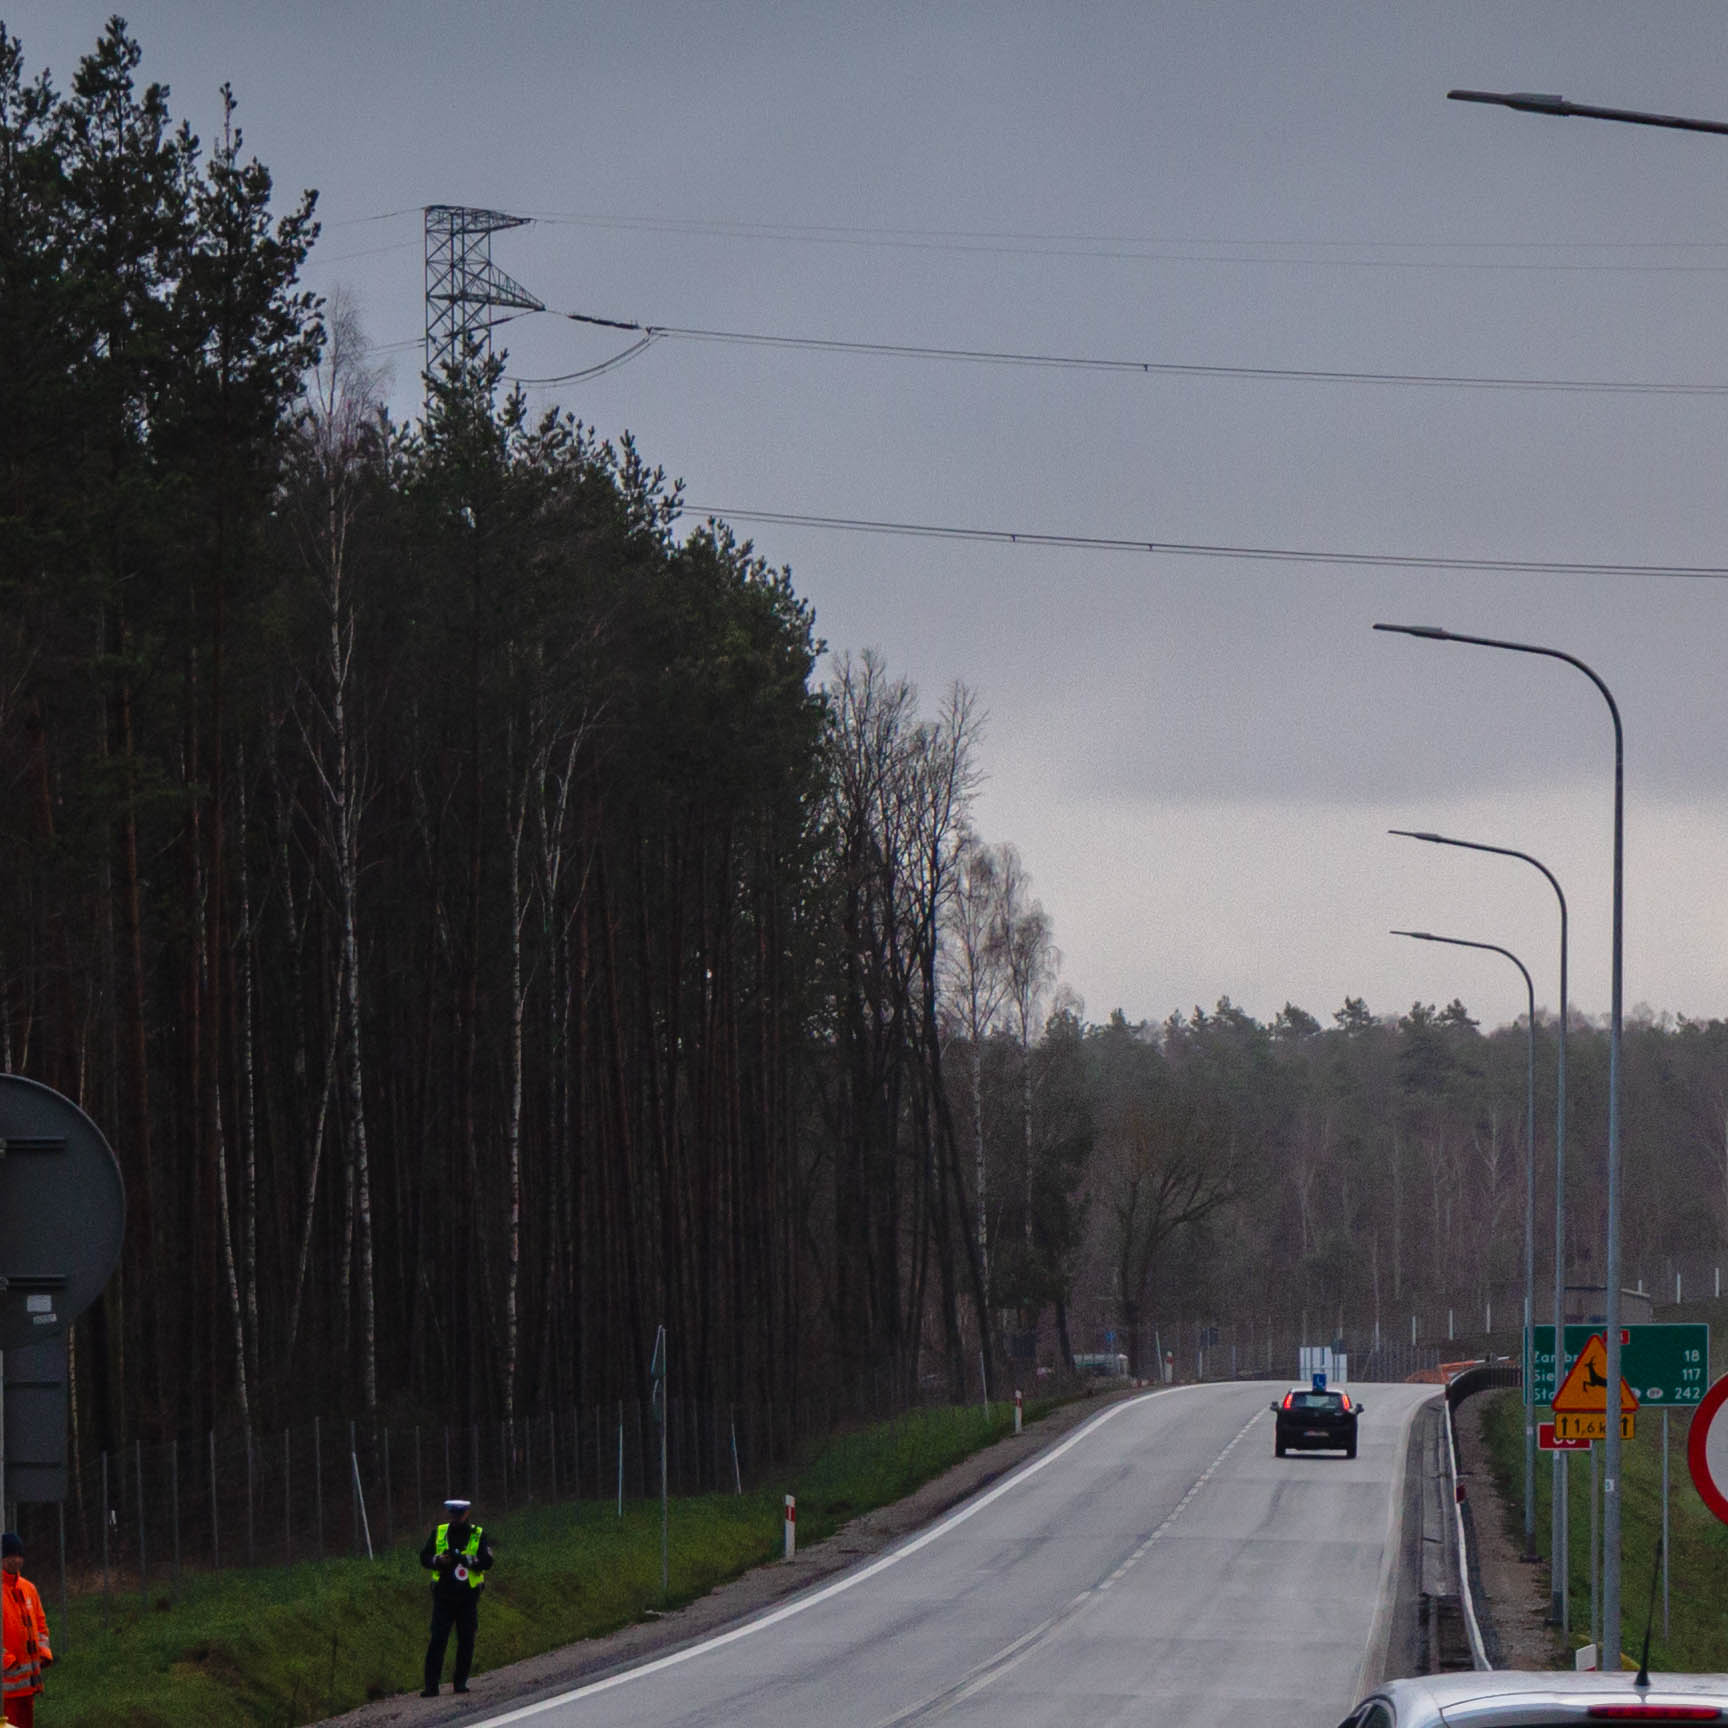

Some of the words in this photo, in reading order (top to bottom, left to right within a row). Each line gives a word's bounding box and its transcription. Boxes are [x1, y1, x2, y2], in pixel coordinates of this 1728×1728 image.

[1683, 1349, 1701, 1363] 18
[1682, 1368, 1701, 1382] 117
[1674, 1386, 1701, 1400] 242
